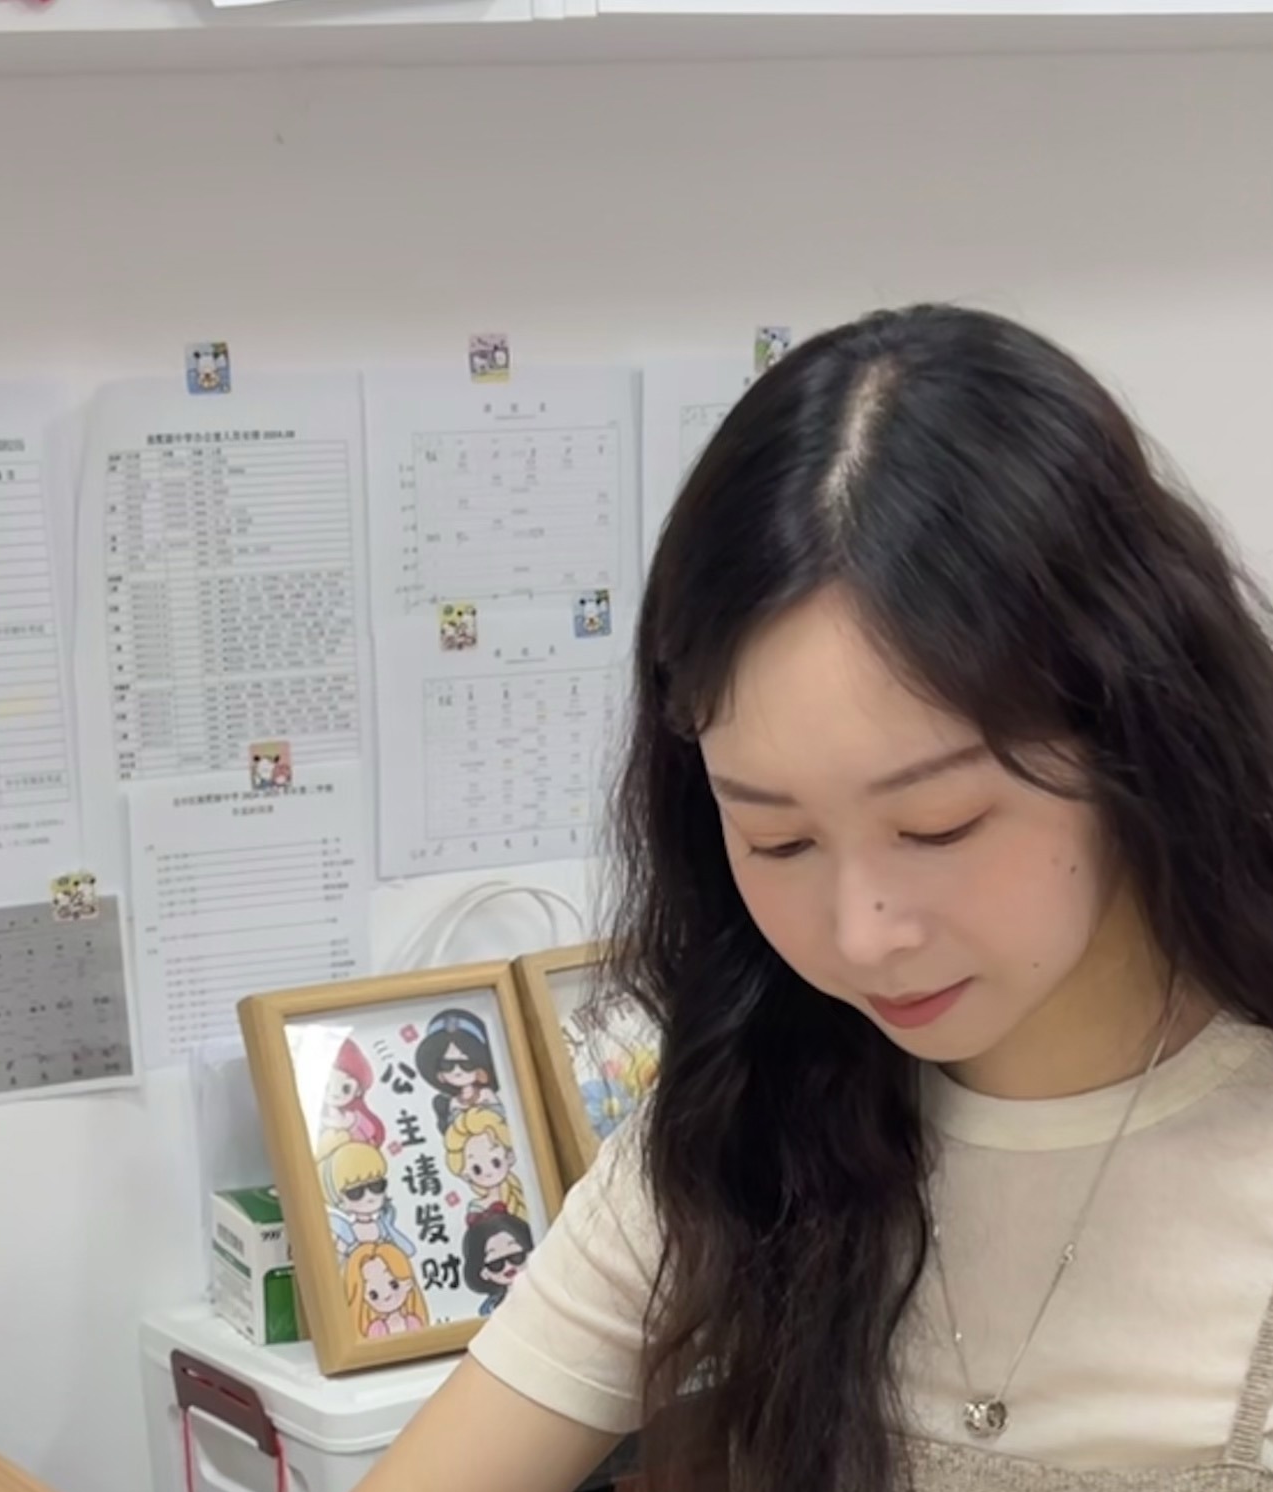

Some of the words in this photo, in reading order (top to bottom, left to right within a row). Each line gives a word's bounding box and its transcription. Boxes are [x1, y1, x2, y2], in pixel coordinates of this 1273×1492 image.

[380, 1061, 462, 1291] 公主请发财
